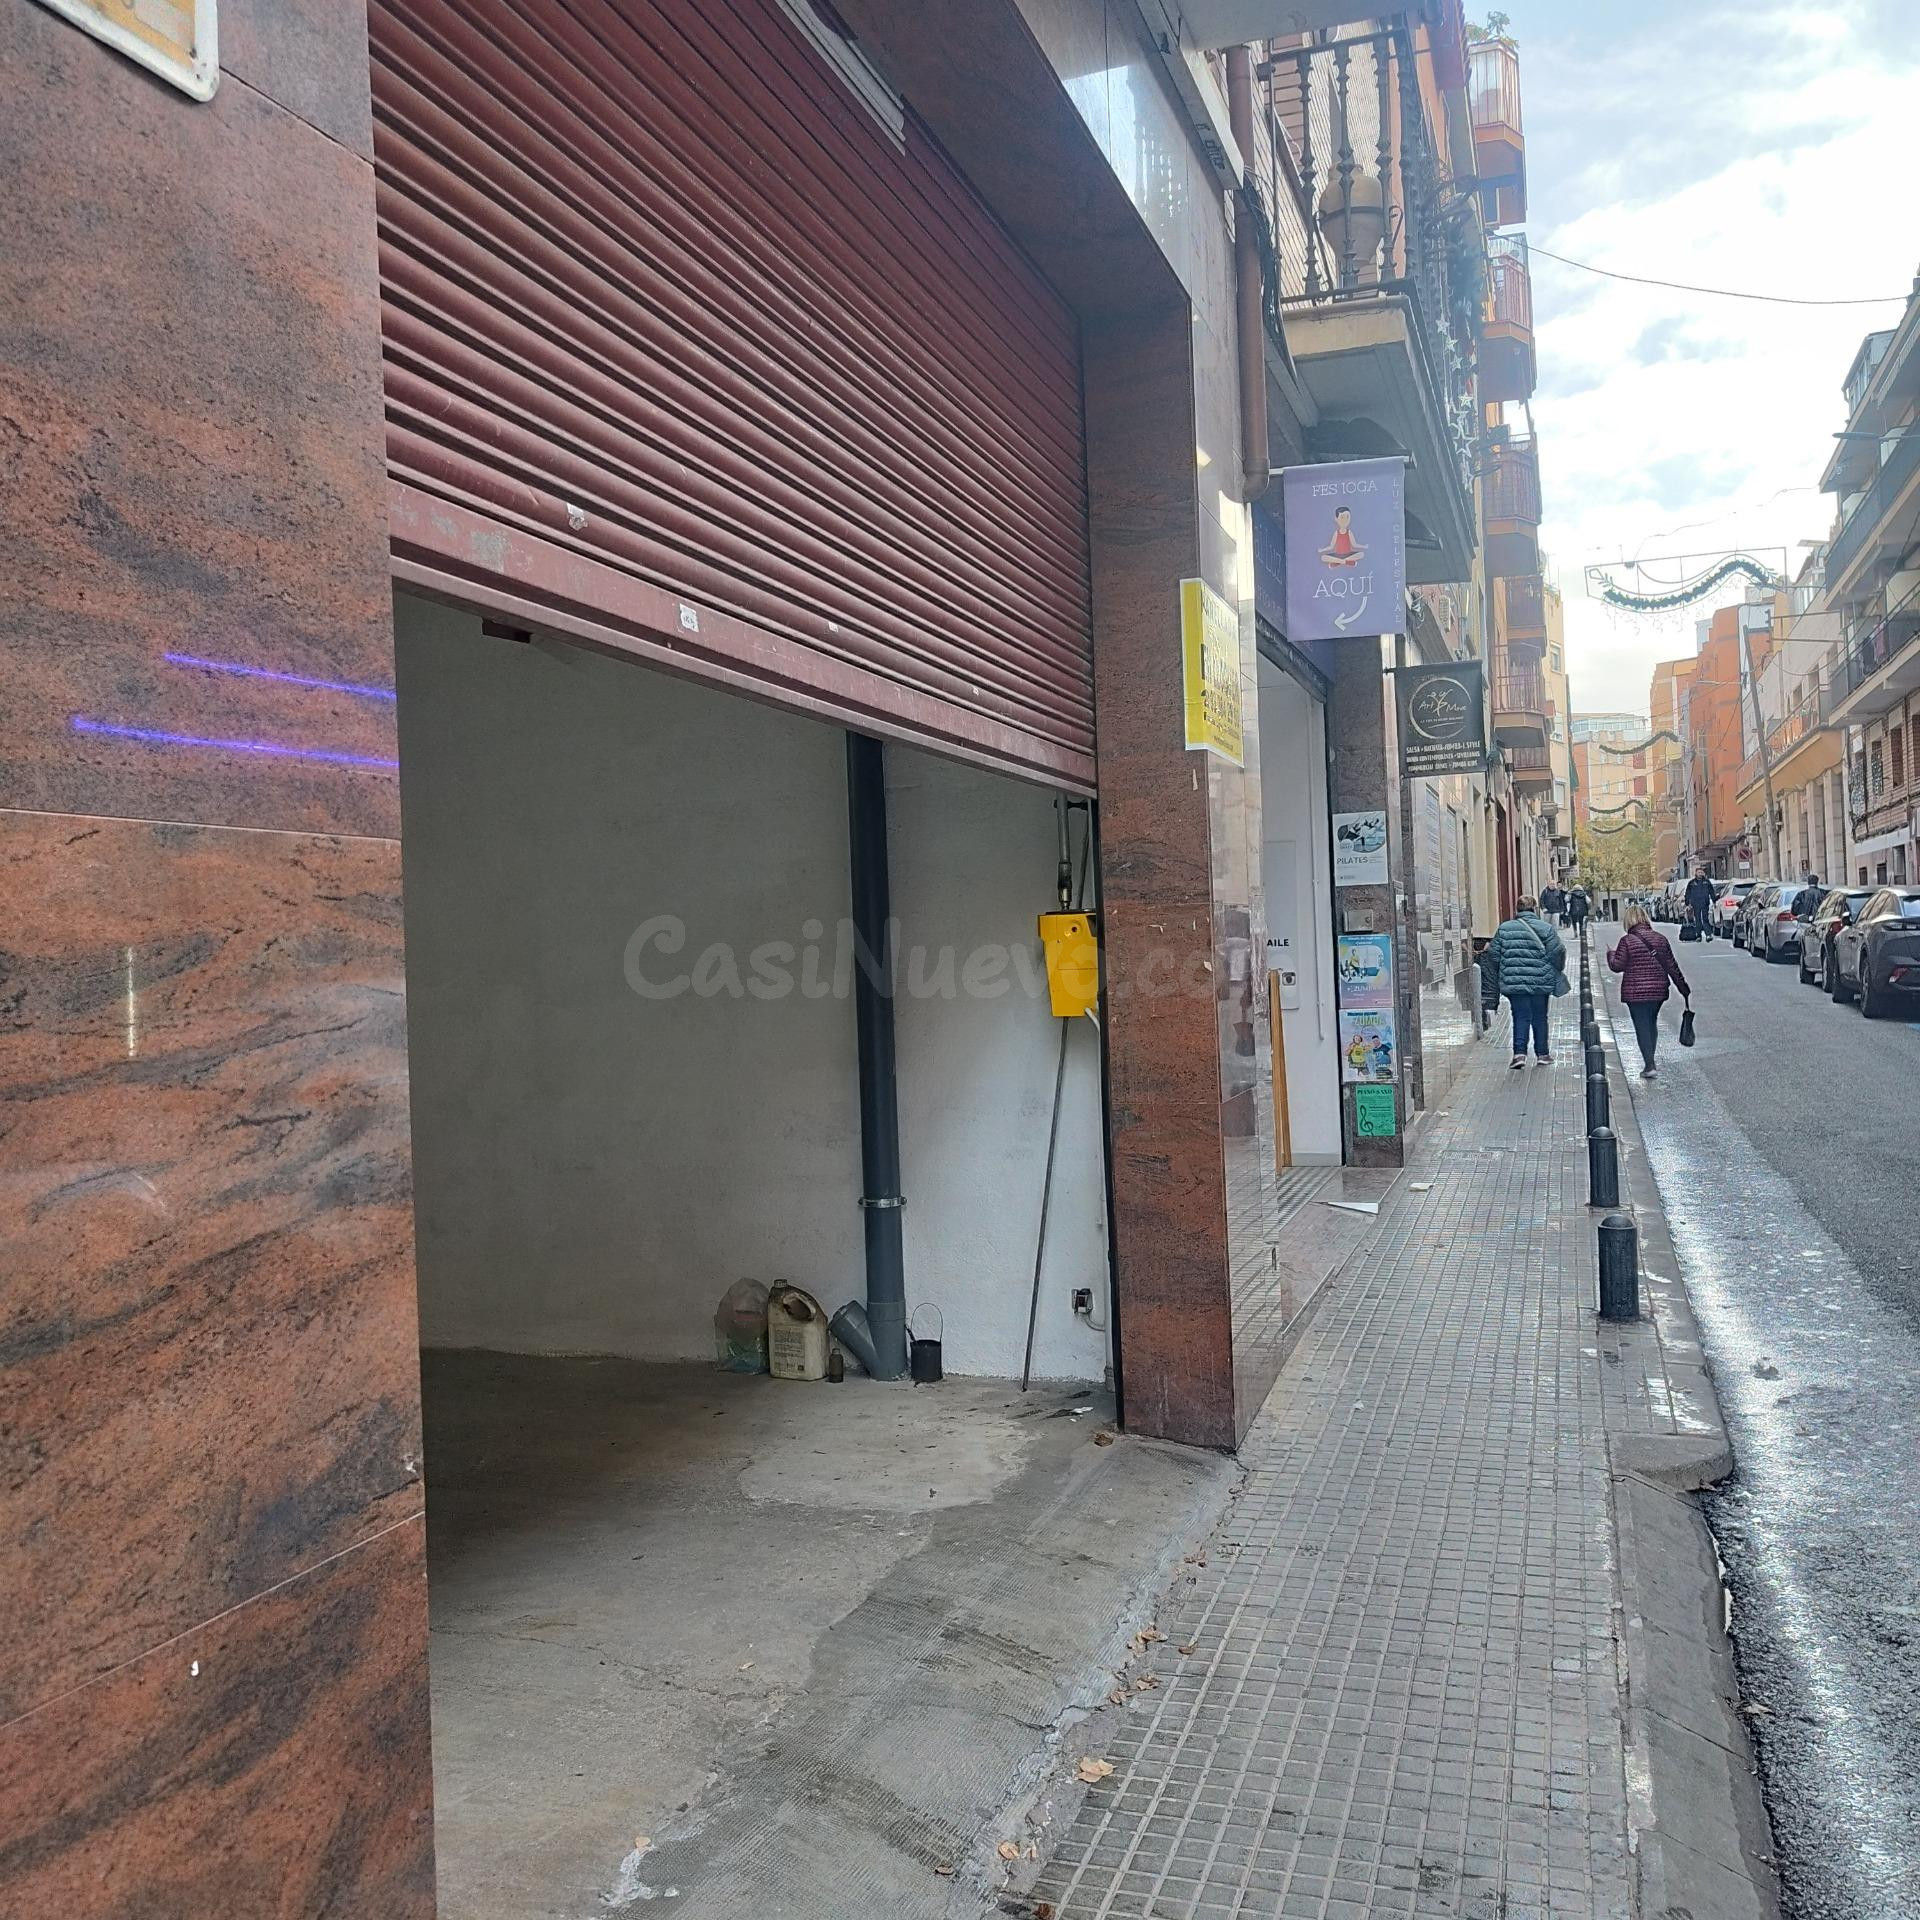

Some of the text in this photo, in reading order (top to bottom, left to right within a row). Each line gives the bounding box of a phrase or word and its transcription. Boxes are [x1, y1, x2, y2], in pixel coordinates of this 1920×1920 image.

[1312, 480, 1378, 497] FES IOGA
[1312, 572, 1374, 598] AQUÍ
